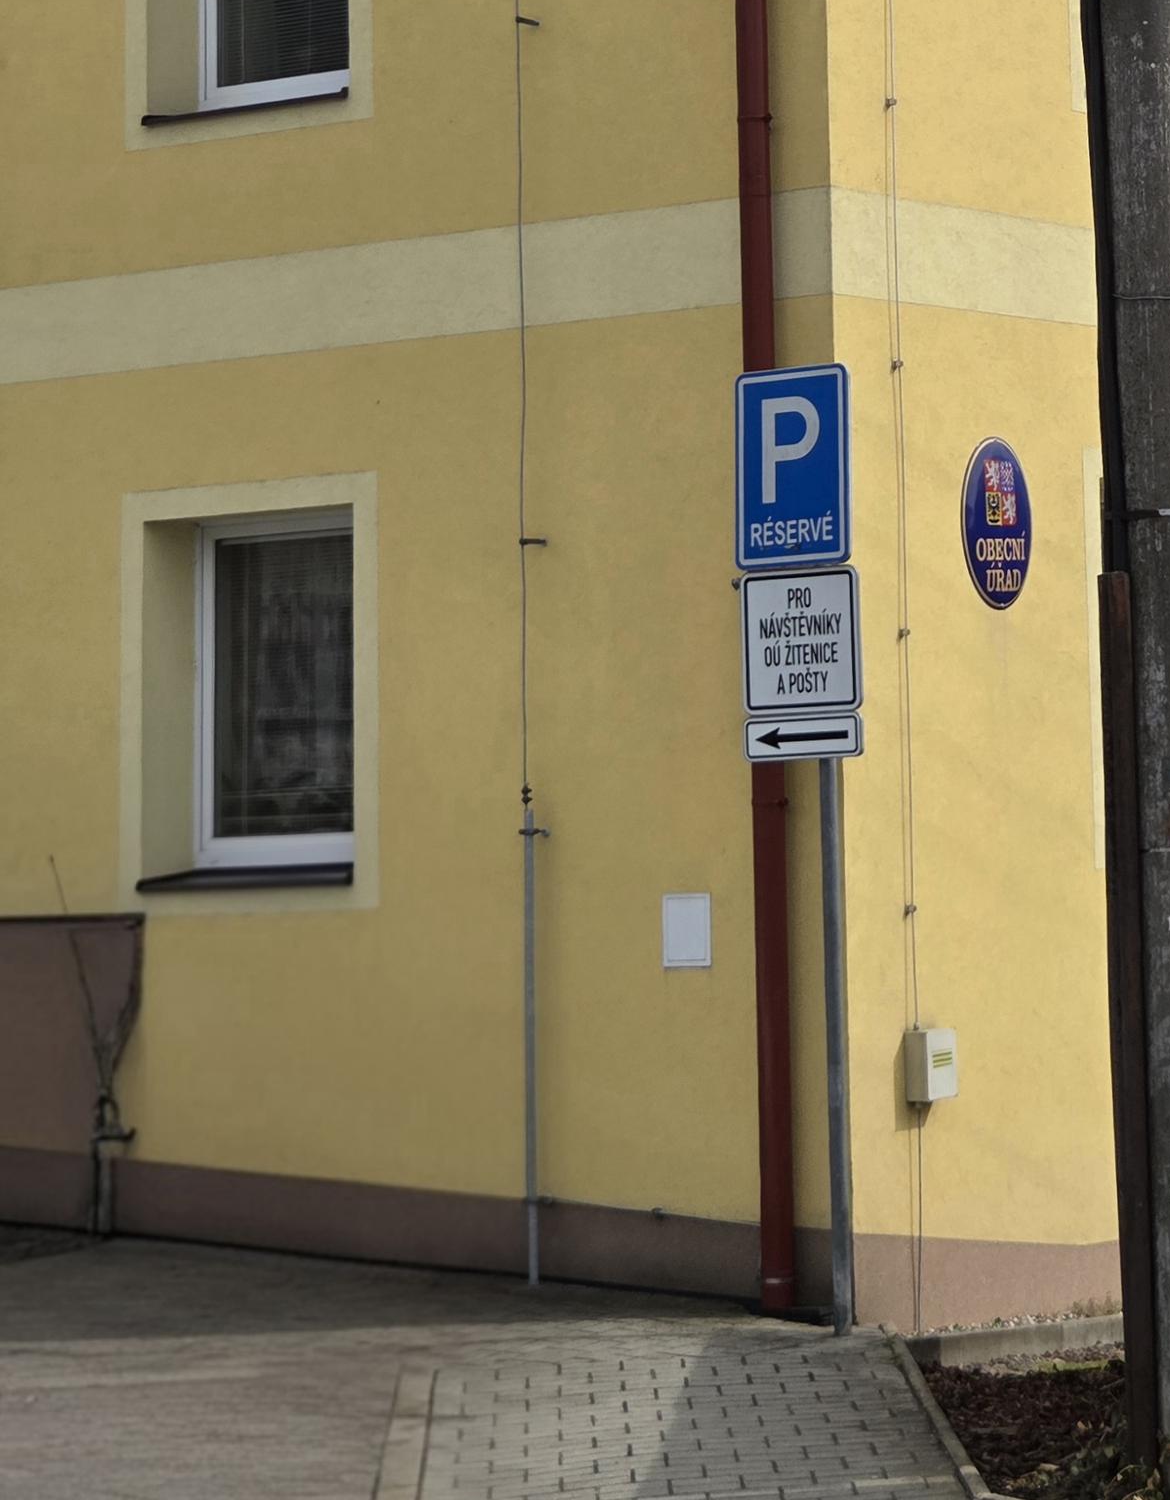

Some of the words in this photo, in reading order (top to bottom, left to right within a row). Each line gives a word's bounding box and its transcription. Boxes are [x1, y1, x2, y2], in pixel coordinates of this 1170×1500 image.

[761, 396, 820, 504] P
[750, 510, 833, 547] RÉSERVÉ
[976, 531, 1026, 561] OBECNÍ
[986, 562, 1022, 592] ÚŘAD
[787, 587, 812, 609] PRO
[760, 608, 841, 640] NÁVŠTĚVNÍKY
[764, 640, 781, 667] OÚ
[785, 640, 839, 666] ŽITENICE
[777, 673, 786, 695] A
[789, 667, 828, 694] POŠTY
